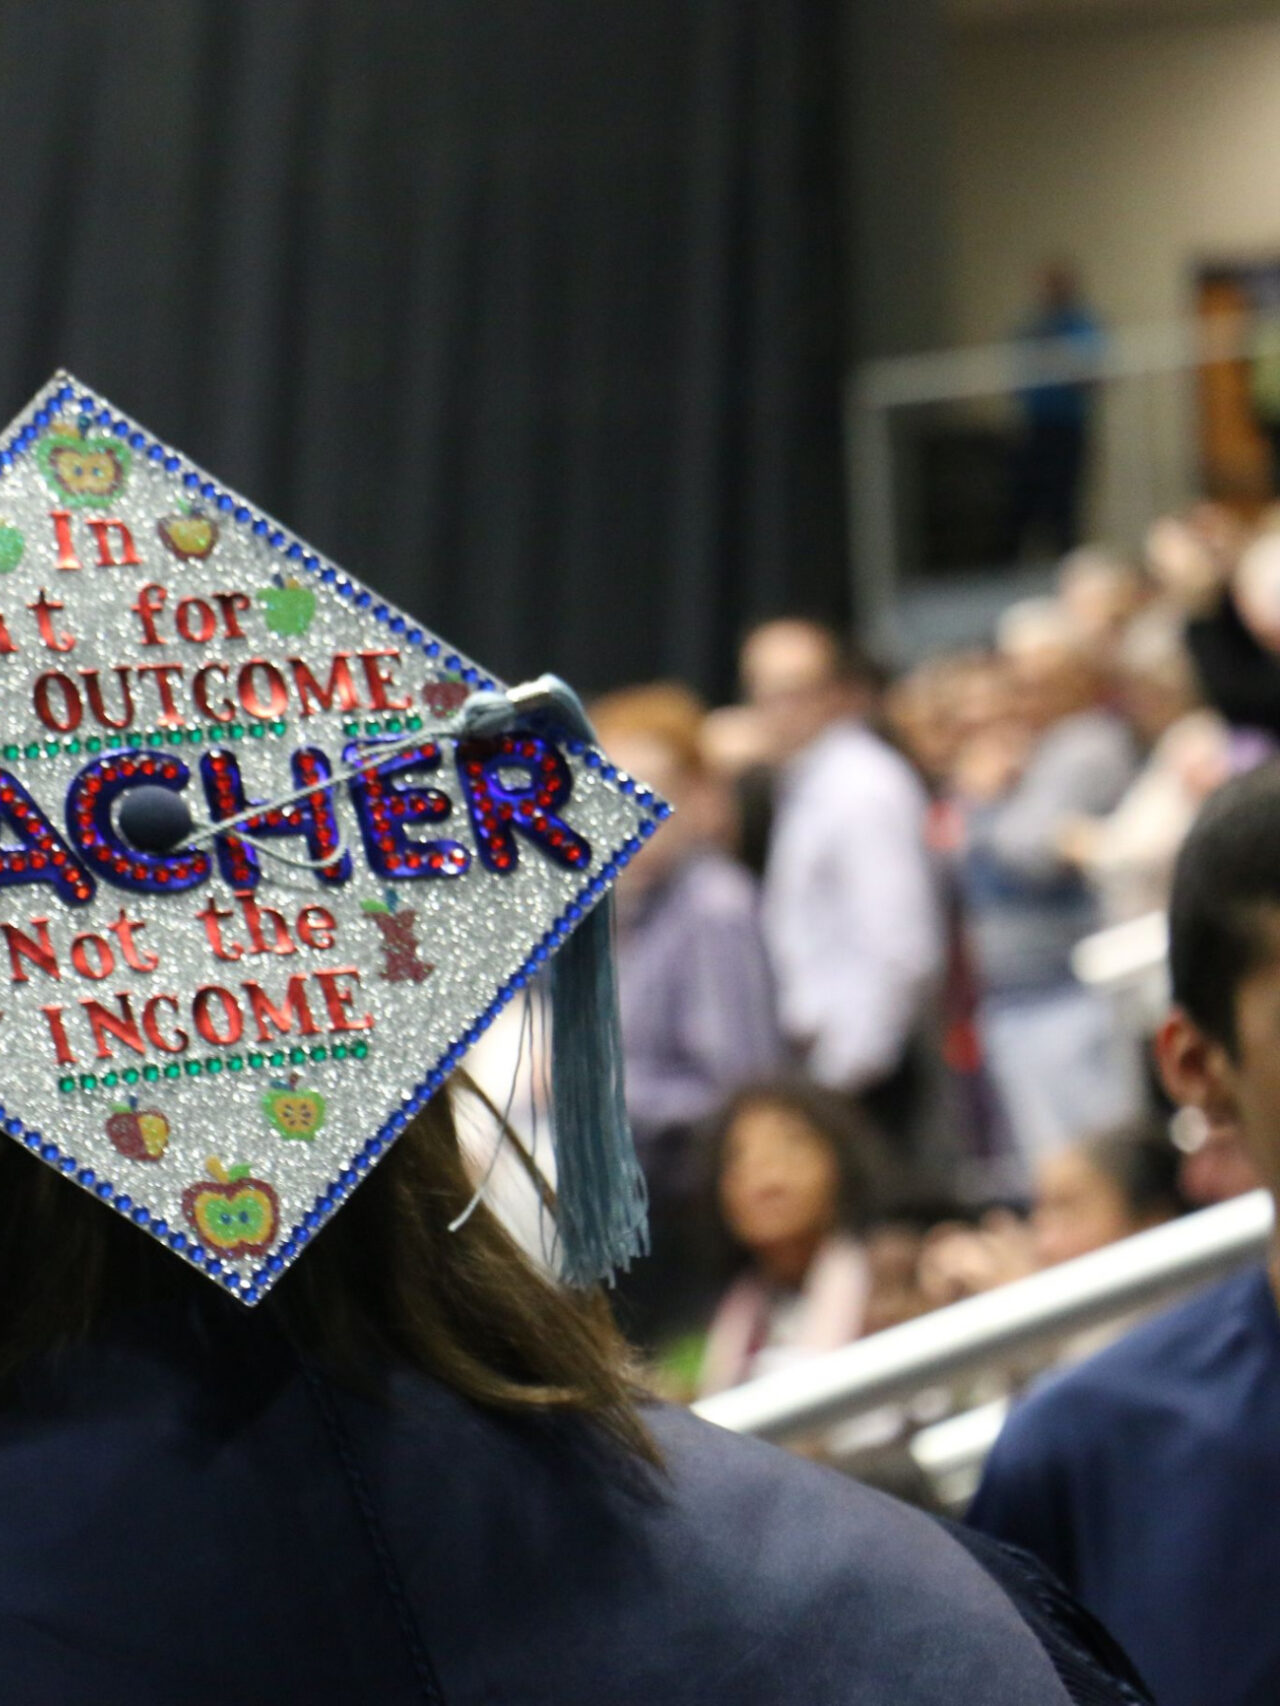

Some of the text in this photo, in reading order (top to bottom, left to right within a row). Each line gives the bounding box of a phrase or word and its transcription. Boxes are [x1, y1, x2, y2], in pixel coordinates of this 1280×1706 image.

[49, 510, 142, 571] In
[130, 583, 251, 646] for
[33, 650, 413, 730] OUTCOME
[0, 890, 339, 984] Not the
[41, 968, 375, 1066] INCOME
